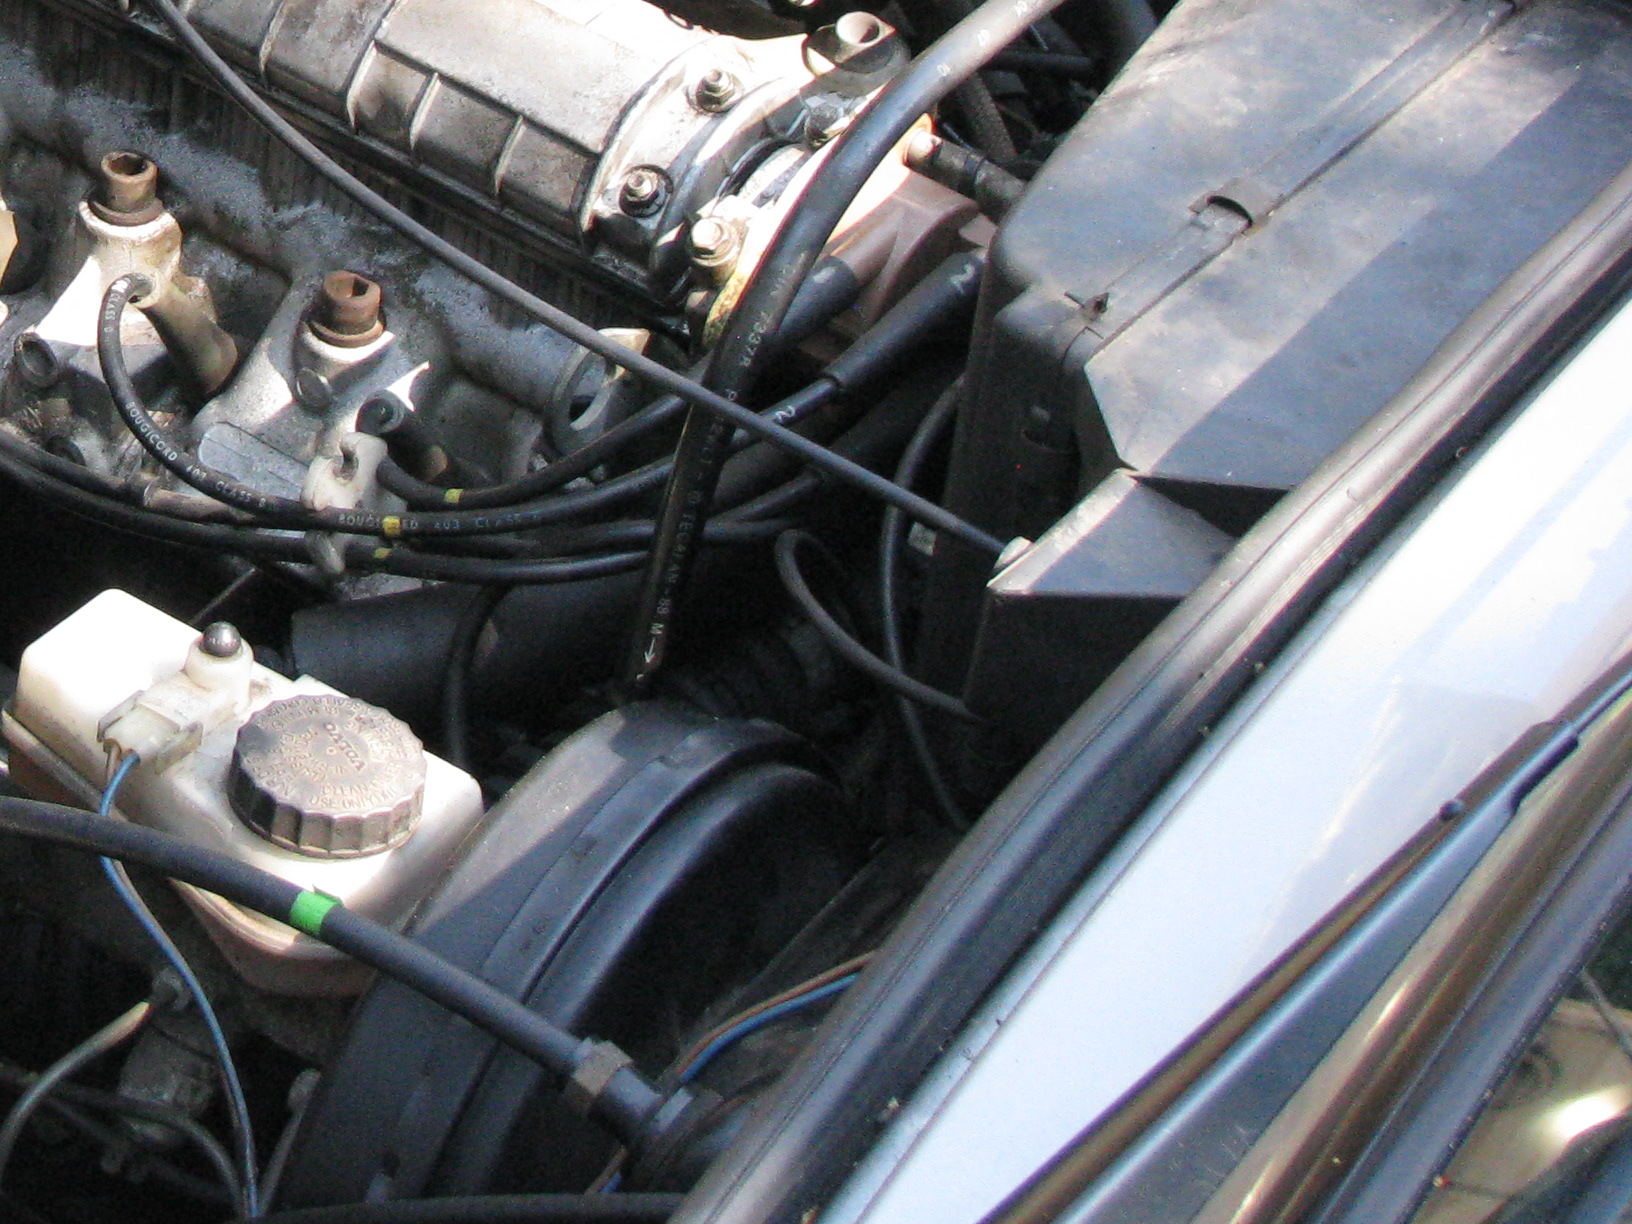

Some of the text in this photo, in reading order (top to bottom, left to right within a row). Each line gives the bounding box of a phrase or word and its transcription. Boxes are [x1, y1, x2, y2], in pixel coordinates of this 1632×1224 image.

[124, 401, 179, 462] BOUGICORD
[214, 480, 253, 503] CLASS
[323, 721, 367, 772] VOLVO
